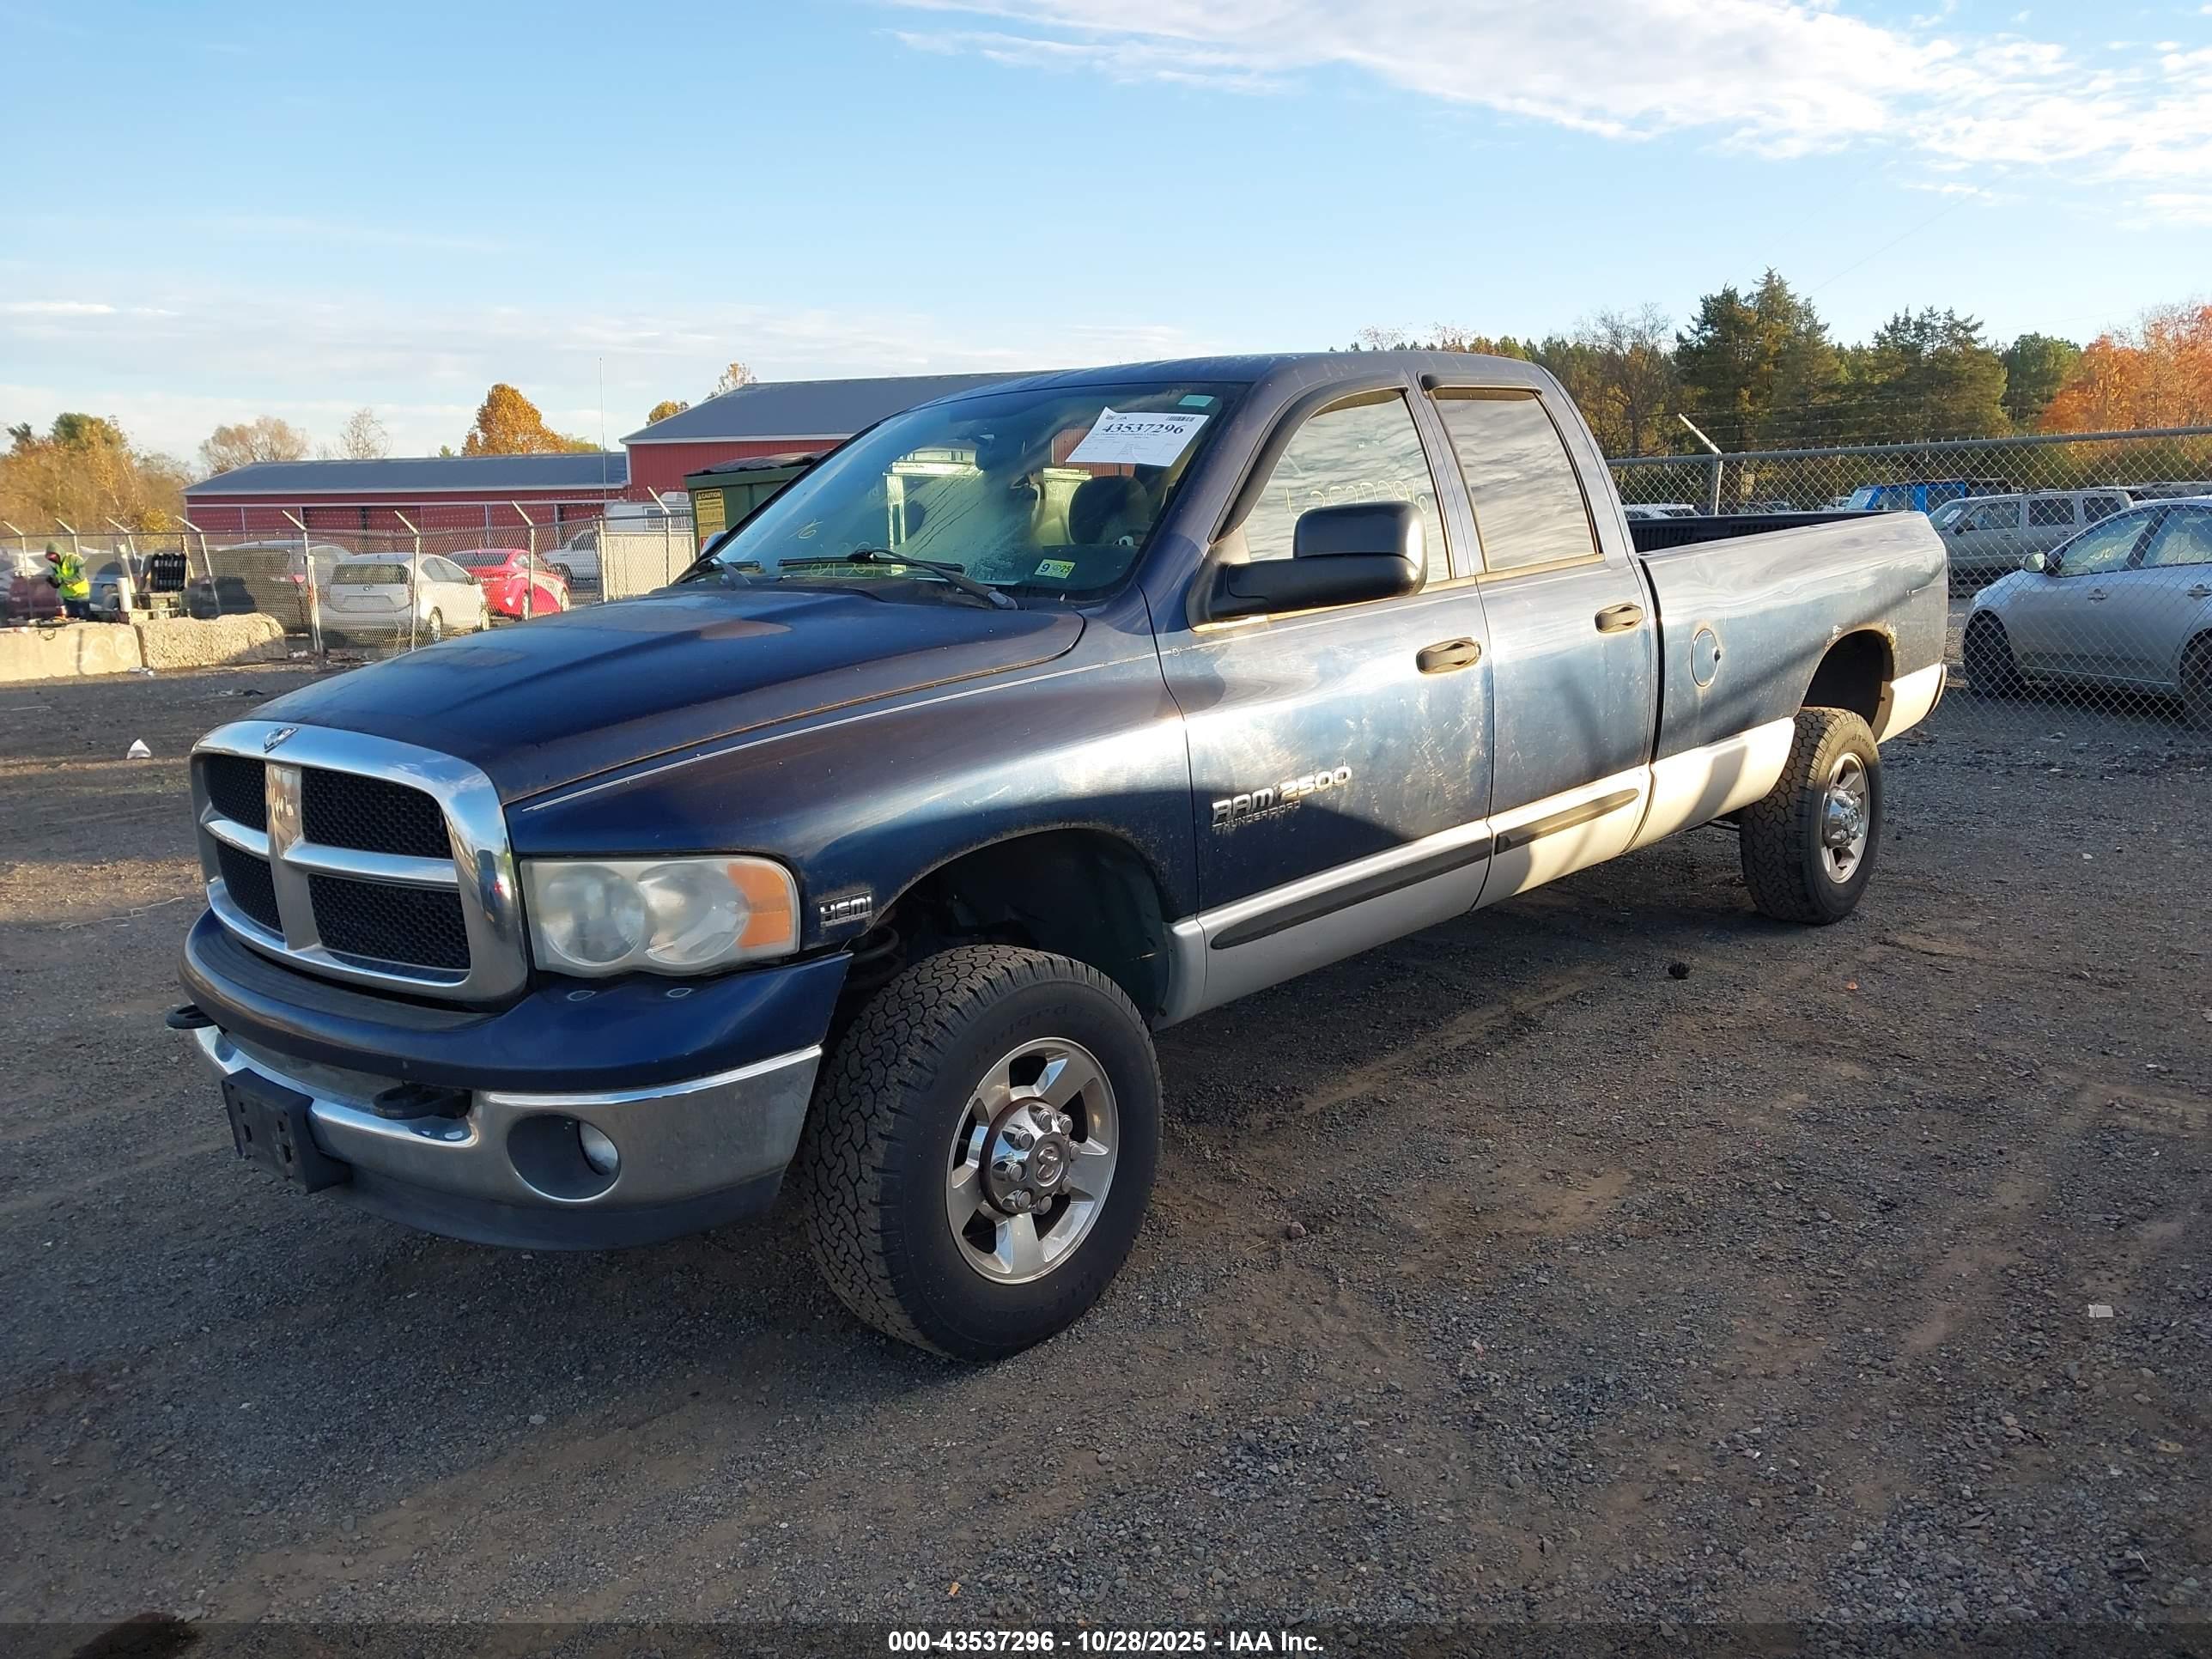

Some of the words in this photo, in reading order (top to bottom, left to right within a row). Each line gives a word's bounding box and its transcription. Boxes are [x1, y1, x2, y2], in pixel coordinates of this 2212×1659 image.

[1102, 422, 1187, 434] 43537296
[1040, 562, 1050, 573] 9
[1060, 565, 1073, 574] 25
[1212, 787, 1274, 825] RAM
[1278, 766, 1352, 802] 2500
